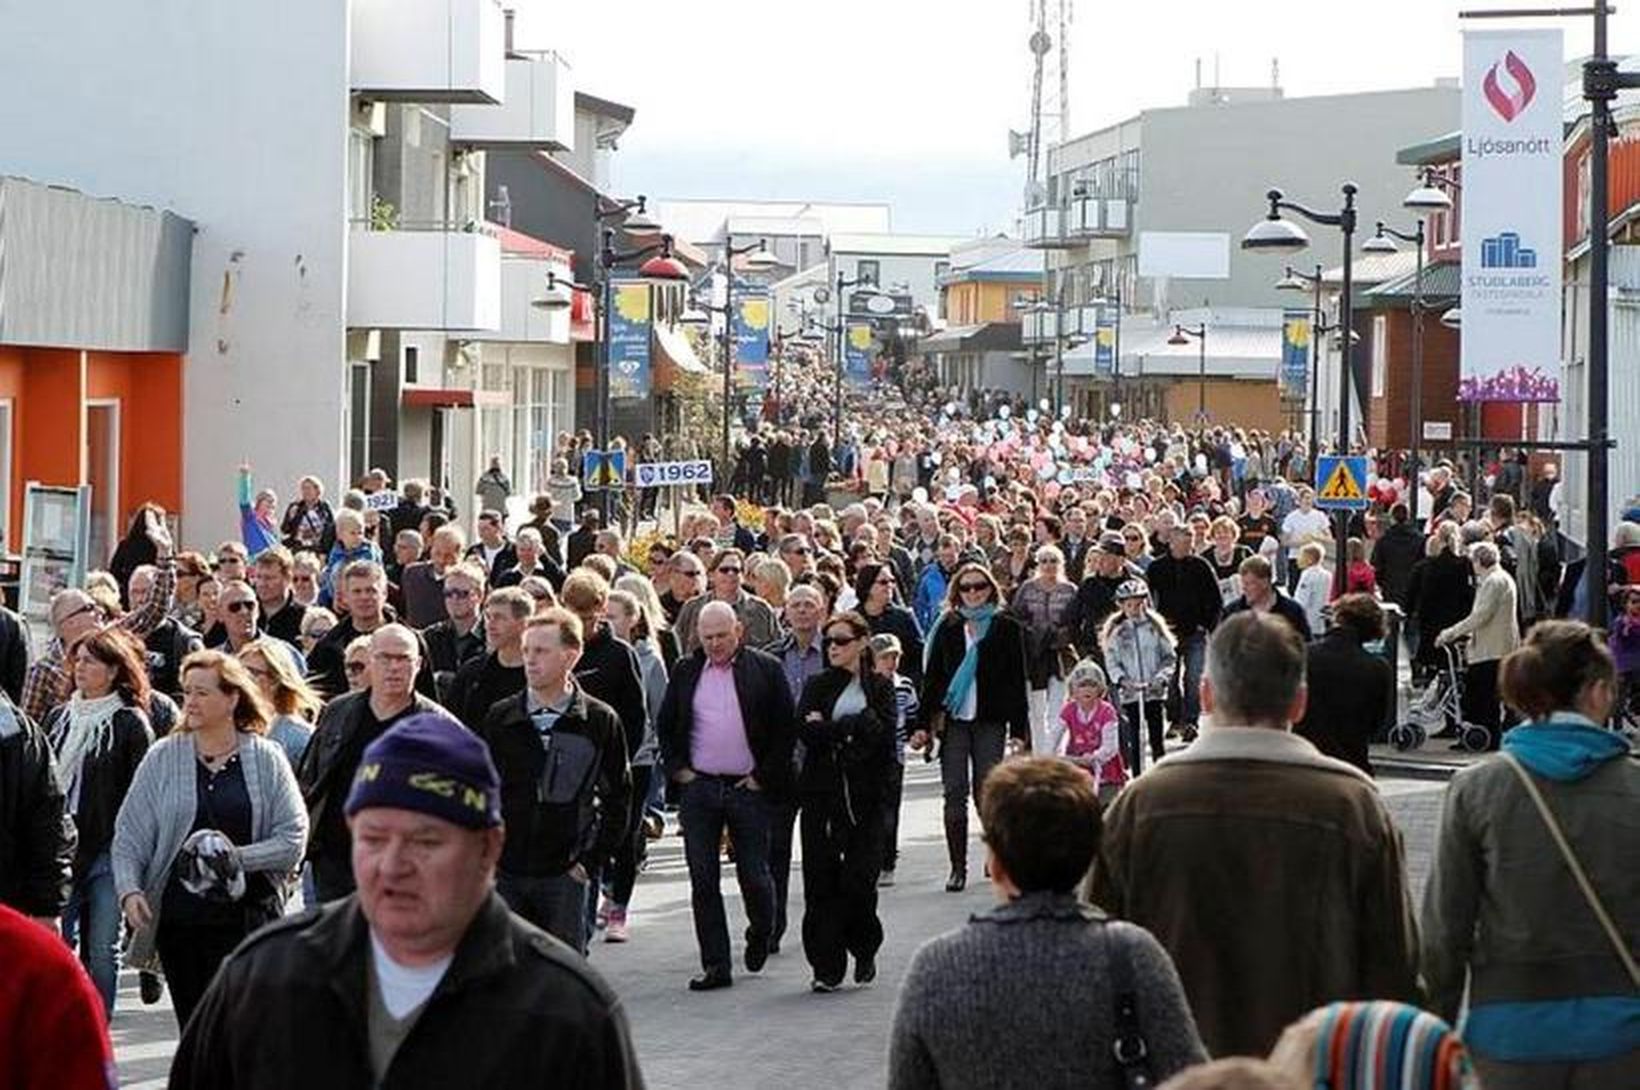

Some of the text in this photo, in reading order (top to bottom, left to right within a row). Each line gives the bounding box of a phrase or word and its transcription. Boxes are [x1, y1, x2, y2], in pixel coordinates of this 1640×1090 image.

[659, 463, 709, 480] 1962
[360, 764, 381, 781] N
[462, 788, 487, 812] N
